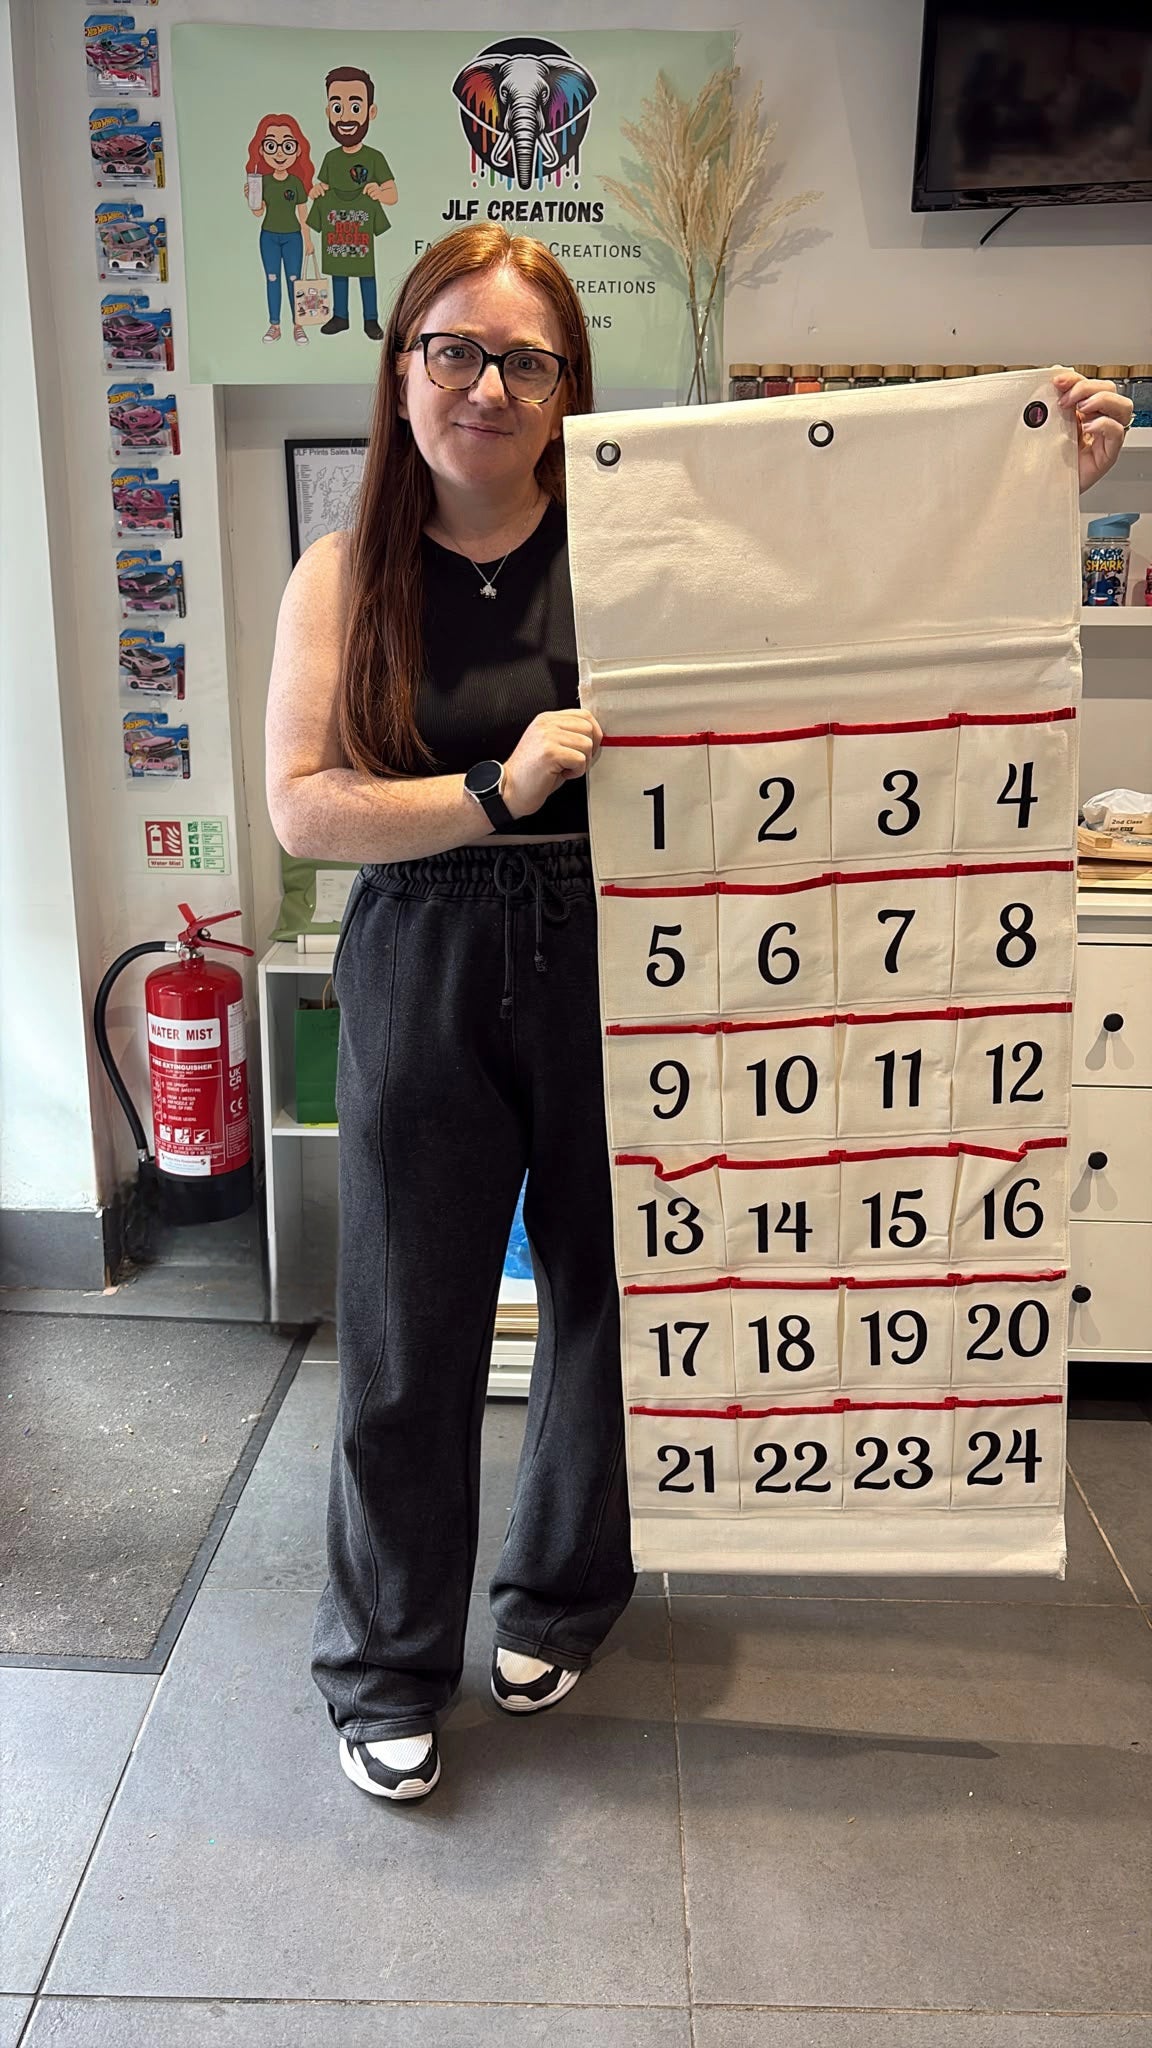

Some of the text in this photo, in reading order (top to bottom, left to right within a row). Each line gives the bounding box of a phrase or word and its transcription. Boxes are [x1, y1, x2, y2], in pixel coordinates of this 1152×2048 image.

[442, 199, 604, 223] JLF CREATIONS
[549, 242, 642, 258] CREATIONS
[569, 278, 656, 294] REATIONS
[296, 448, 307, 456] JLF
[310, 448, 328, 456] Prints
[330, 448, 349, 456] Sales
[1085, 560, 1124, 572] SHARK
[643, 783, 665, 850] 1
[757, 776, 798, 843] 2
[877, 769, 921, 837] 3
[996, 761, 1039, 829] 4
[646, 924, 686, 988] 5
[757, 921, 800, 986] 6
[877, 909, 916, 974] 7
[996, 902, 1037, 969] 8
[151, 1023, 213, 1041] WATER MIST
[163, 1062, 213, 1070] EXTINGUISHER
[649, 1060, 690, 1120] 9
[746, 1055, 818, 1117] 10
[874, 1048, 922, 1109] 11
[985, 1041, 1044, 1105] 12
[230, 1097, 243, 1113] CE
[637, 1196, 704, 1258] 13
[748, 1200, 813, 1254] 14
[862, 1188, 927, 1249] 15
[982, 1177, 1044, 1241] 16
[648, 1321, 710, 1377] 17
[748, 1314, 815, 1374] 18
[860, 1309, 928, 1366] 19
[966, 1299, 1050, 1361] 20
[657, 1444, 715, 1494] 21
[753, 1441, 832, 1494] 22
[853, 1436, 934, 1491] 23
[966, 1428, 1043, 1486] 24
